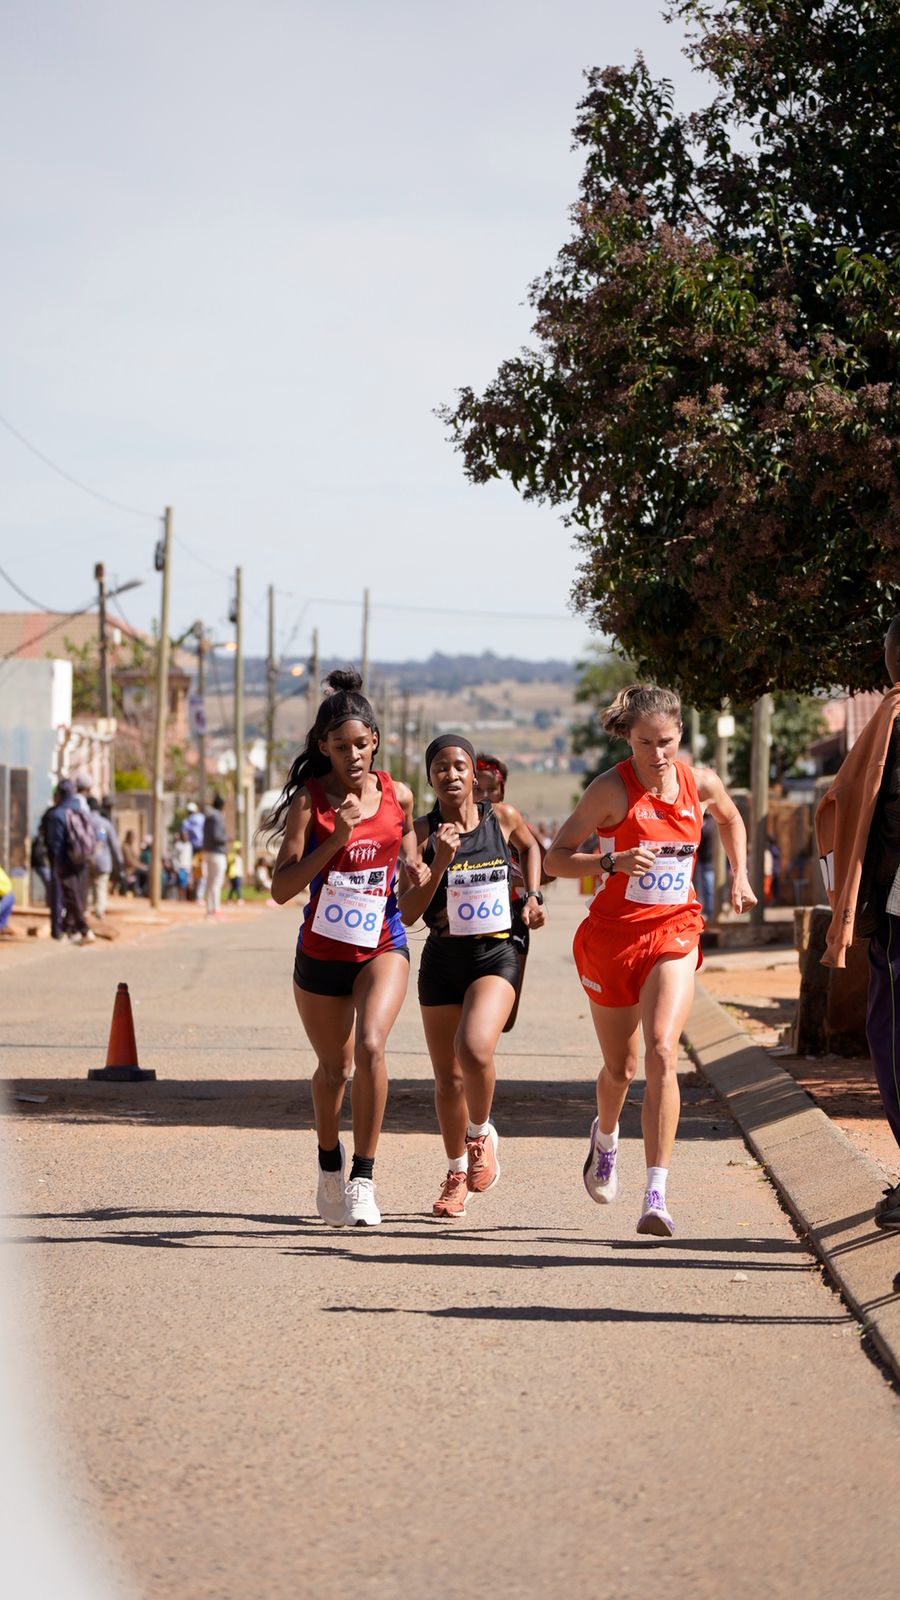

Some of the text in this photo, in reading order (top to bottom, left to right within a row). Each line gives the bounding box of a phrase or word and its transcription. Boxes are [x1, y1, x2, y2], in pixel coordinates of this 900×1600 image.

[470, 873, 487, 883] 2026
[638, 872, 685, 891] 005
[325, 904, 377, 931] 008
[457, 899, 504, 921] 066
